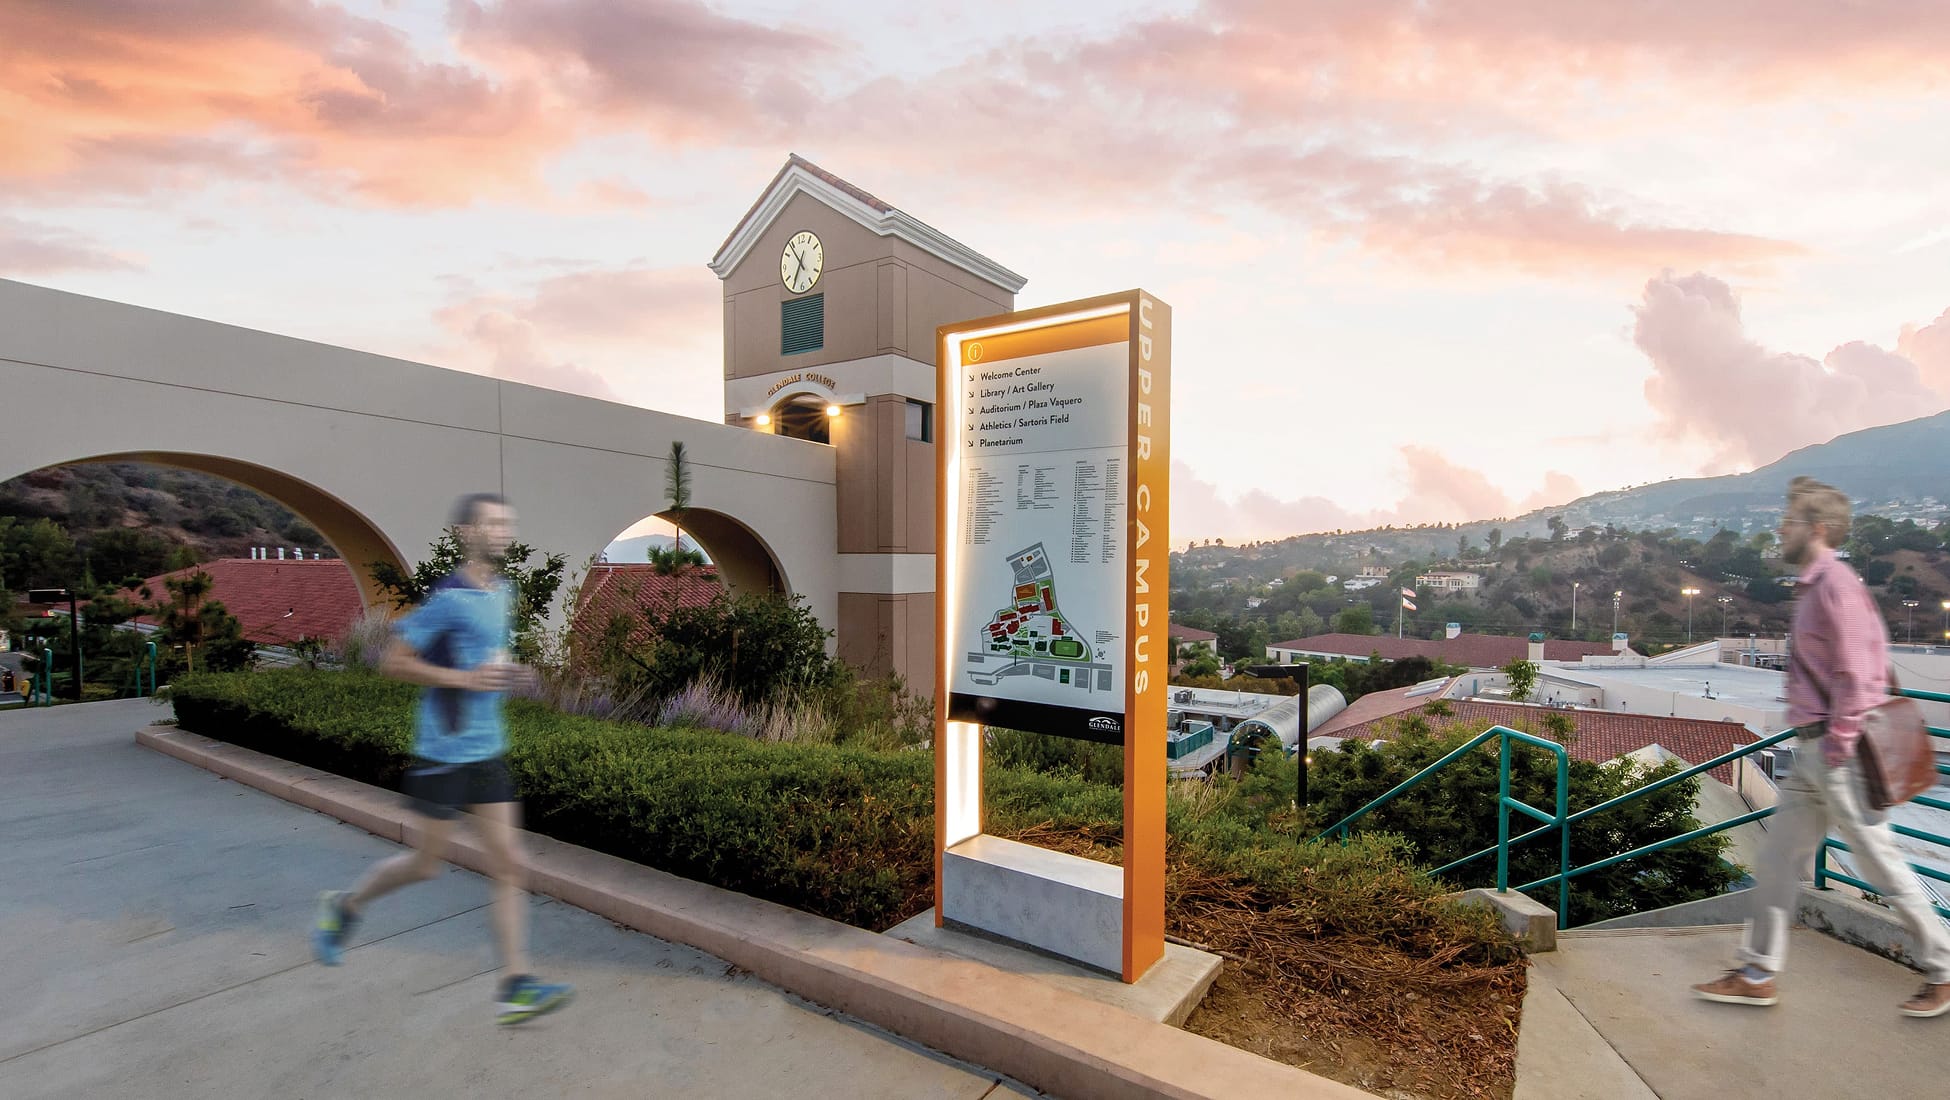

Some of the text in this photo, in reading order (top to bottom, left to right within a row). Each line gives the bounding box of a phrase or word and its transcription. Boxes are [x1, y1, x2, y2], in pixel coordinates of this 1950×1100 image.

[980, 367, 1041, 381] Welcome Center
[767, 374, 801, 396] GLENDALE
[980, 388, 1006, 399] Library
[1012, 385, 1025, 394] Art
[1026, 381, 1055, 393] Gallery
[980, 403, 1021, 415] Auditorium
[1028, 399, 1048, 409] Plaza
[1049, 396, 1083, 409] Vaquero
[979, 420, 1012, 432] Athletics
[1018, 416, 1048, 428] Sartoris
[1050, 413, 1070, 424] Field
[979, 436, 1024, 448] Planetarium
[1135, 299, 1152, 694] UPPER CAMPUS
[1088, 722, 1121, 731] GLENDALE
